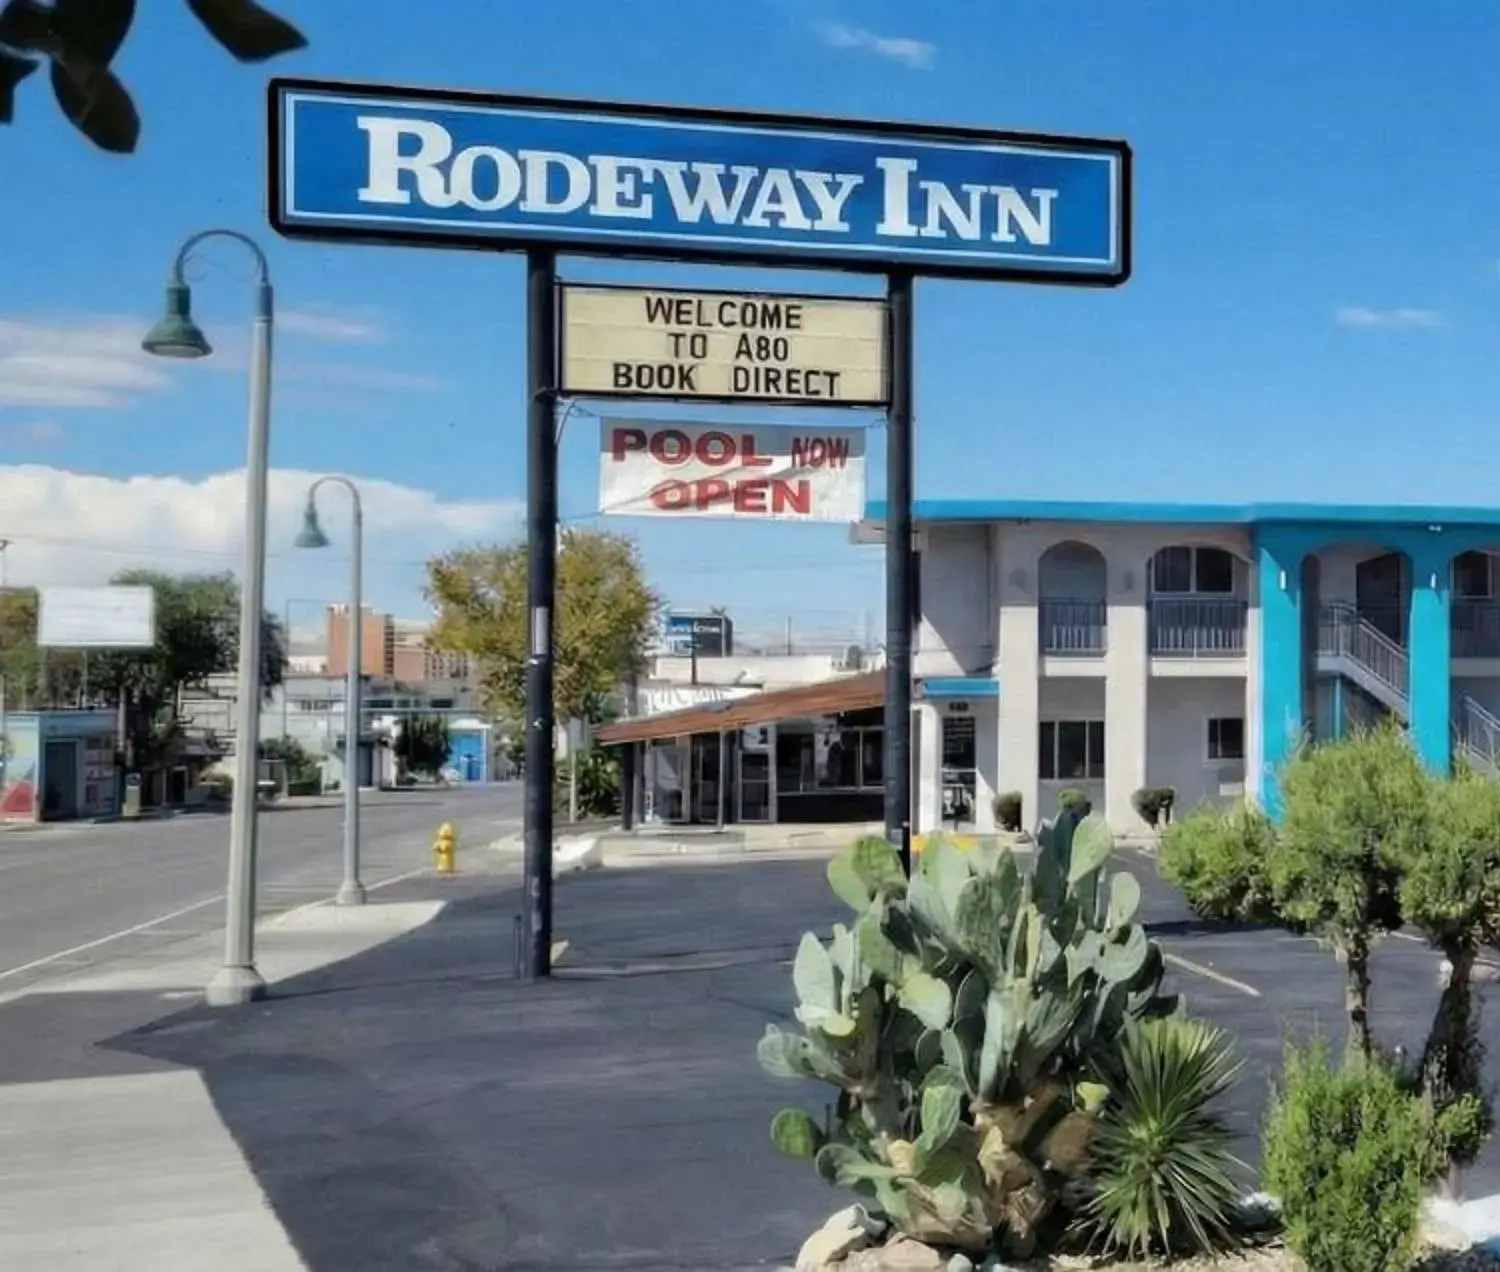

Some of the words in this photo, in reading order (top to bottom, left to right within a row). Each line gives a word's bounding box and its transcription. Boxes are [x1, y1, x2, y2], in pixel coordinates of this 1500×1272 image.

[357, 115, 864, 233] RODEWAY
[875, 157, 1059, 246] INN
[645, 296, 802, 330] WELCOME
[669, 333, 708, 360] TO
[612, 363, 697, 391] BOOK
[732, 367, 840, 397] DIRECT
[612, 428, 774, 467] POOL
[791, 437, 849, 469] NOW
[651, 480, 811, 514] OPEN
